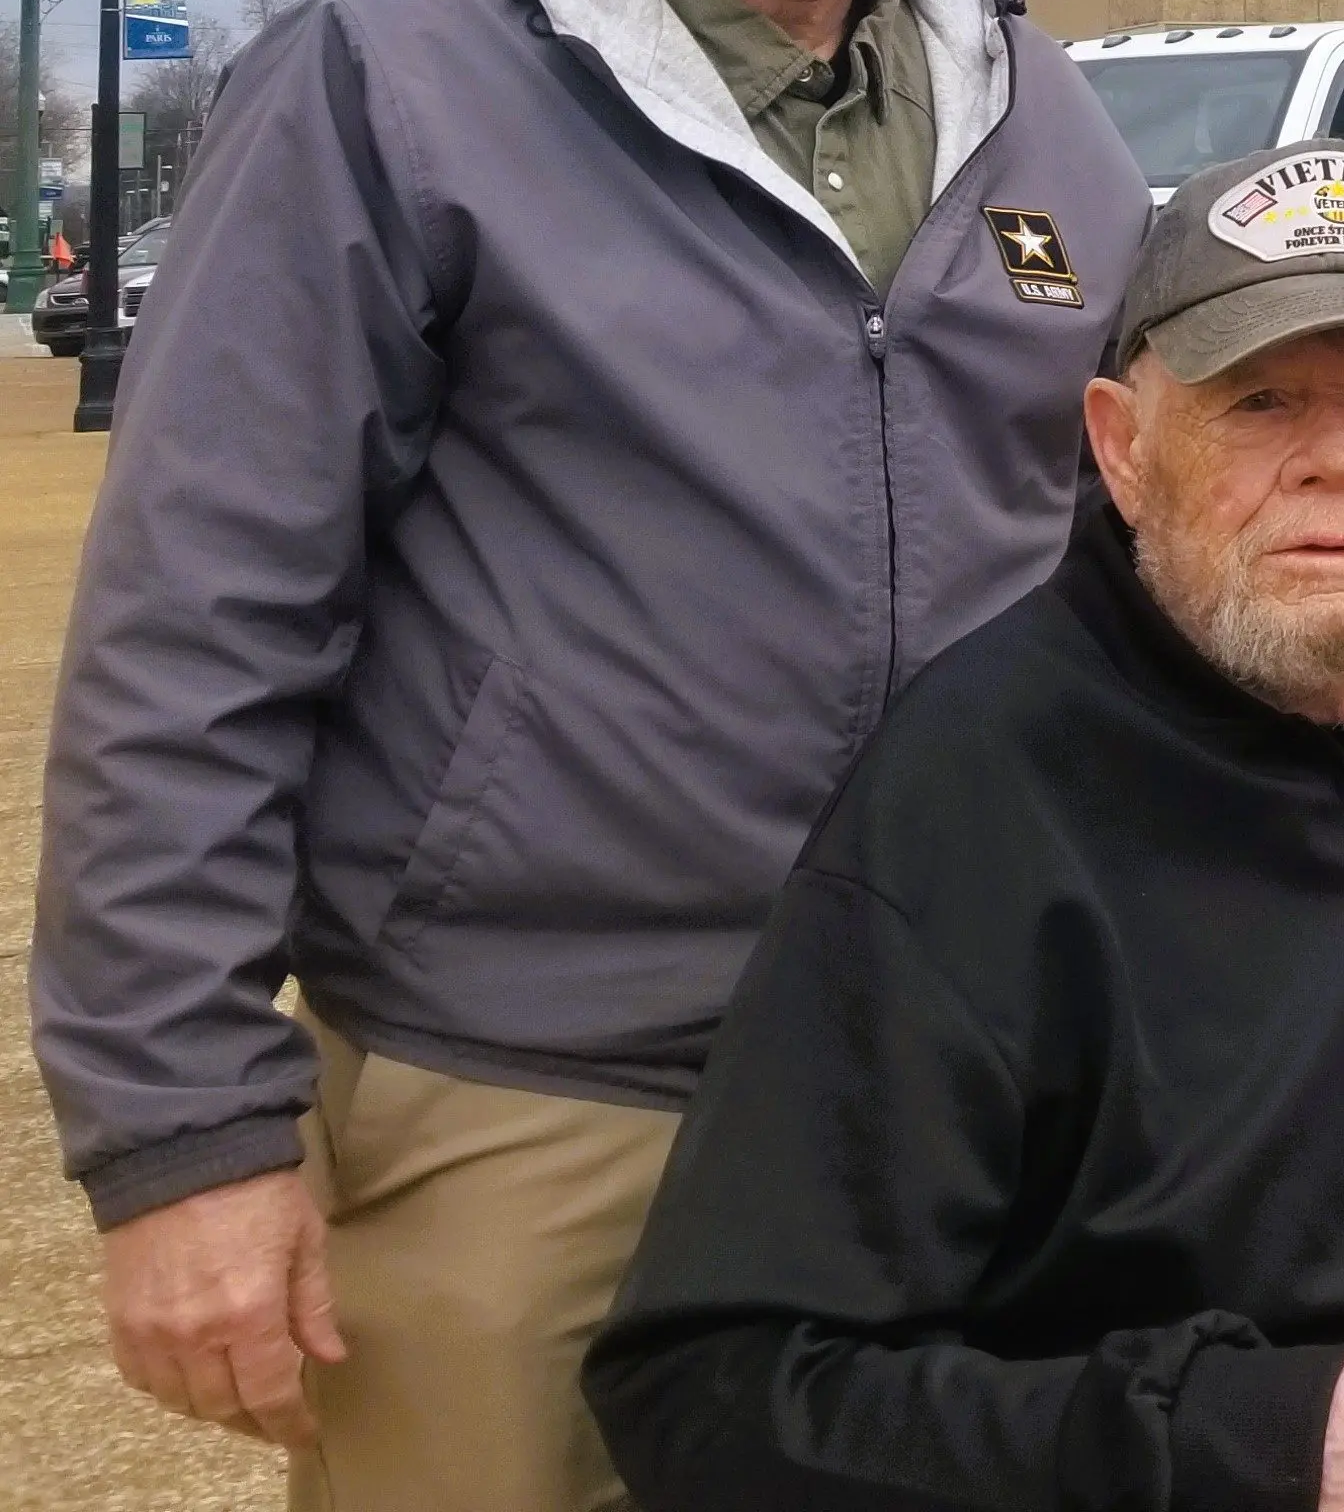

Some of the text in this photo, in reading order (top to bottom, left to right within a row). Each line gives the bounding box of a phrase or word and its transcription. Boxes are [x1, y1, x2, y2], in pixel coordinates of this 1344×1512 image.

[145, 34, 172, 43] PARIS
[1293, 226, 1327, 238] ONCE
[1285, 236, 1340, 250] FOREVER
[1020, 283, 1075, 301] U.S. ARMY
